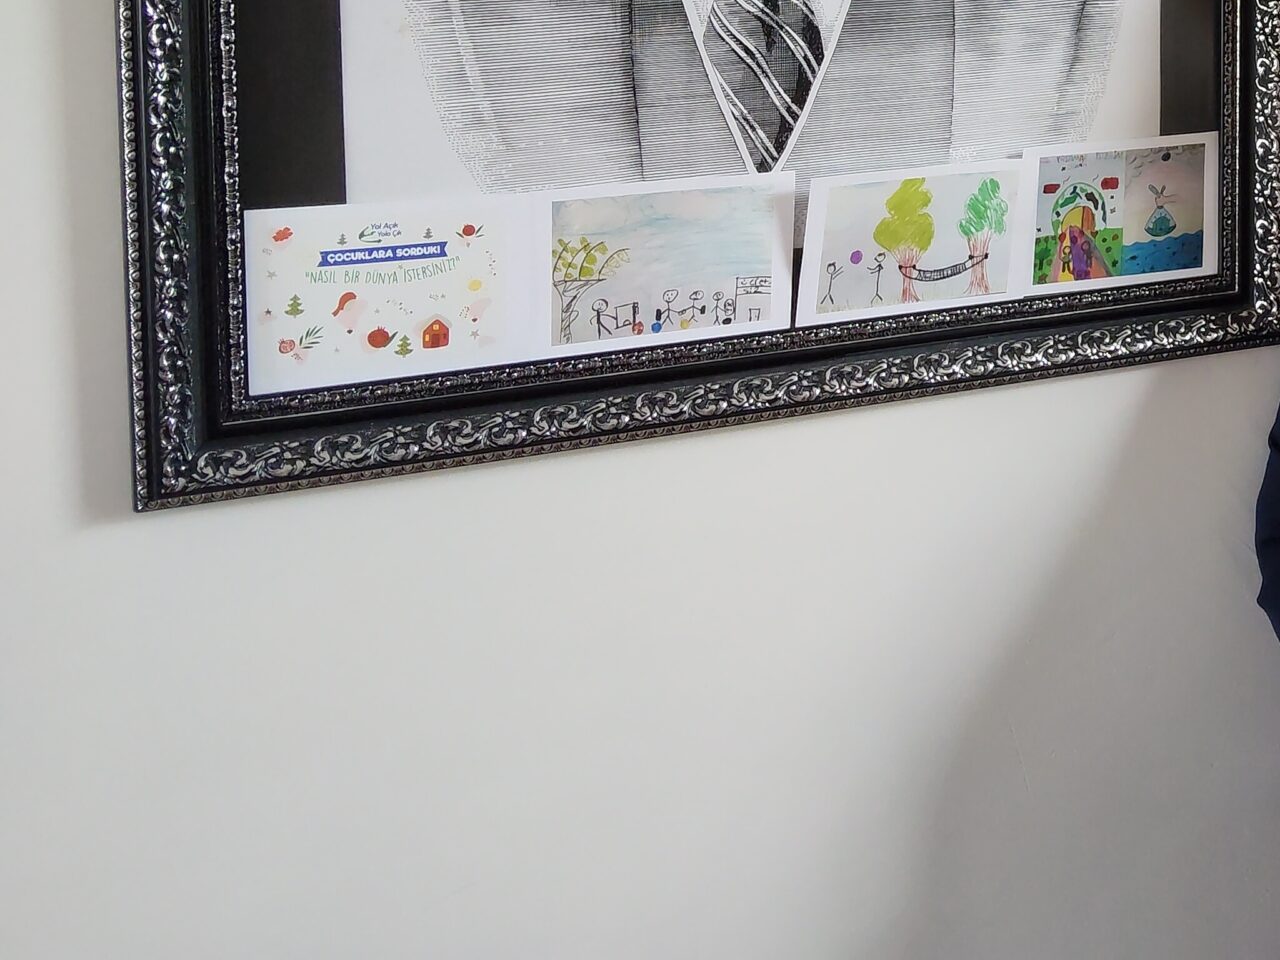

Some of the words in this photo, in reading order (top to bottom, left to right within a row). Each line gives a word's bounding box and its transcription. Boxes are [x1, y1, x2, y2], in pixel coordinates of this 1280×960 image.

[383, 222, 399, 230] Açık
[327, 250, 393, 264] ÇOCUKLARA
[344, 270, 360, 283] BİR
[365, 270, 398, 285] DÜNYA
